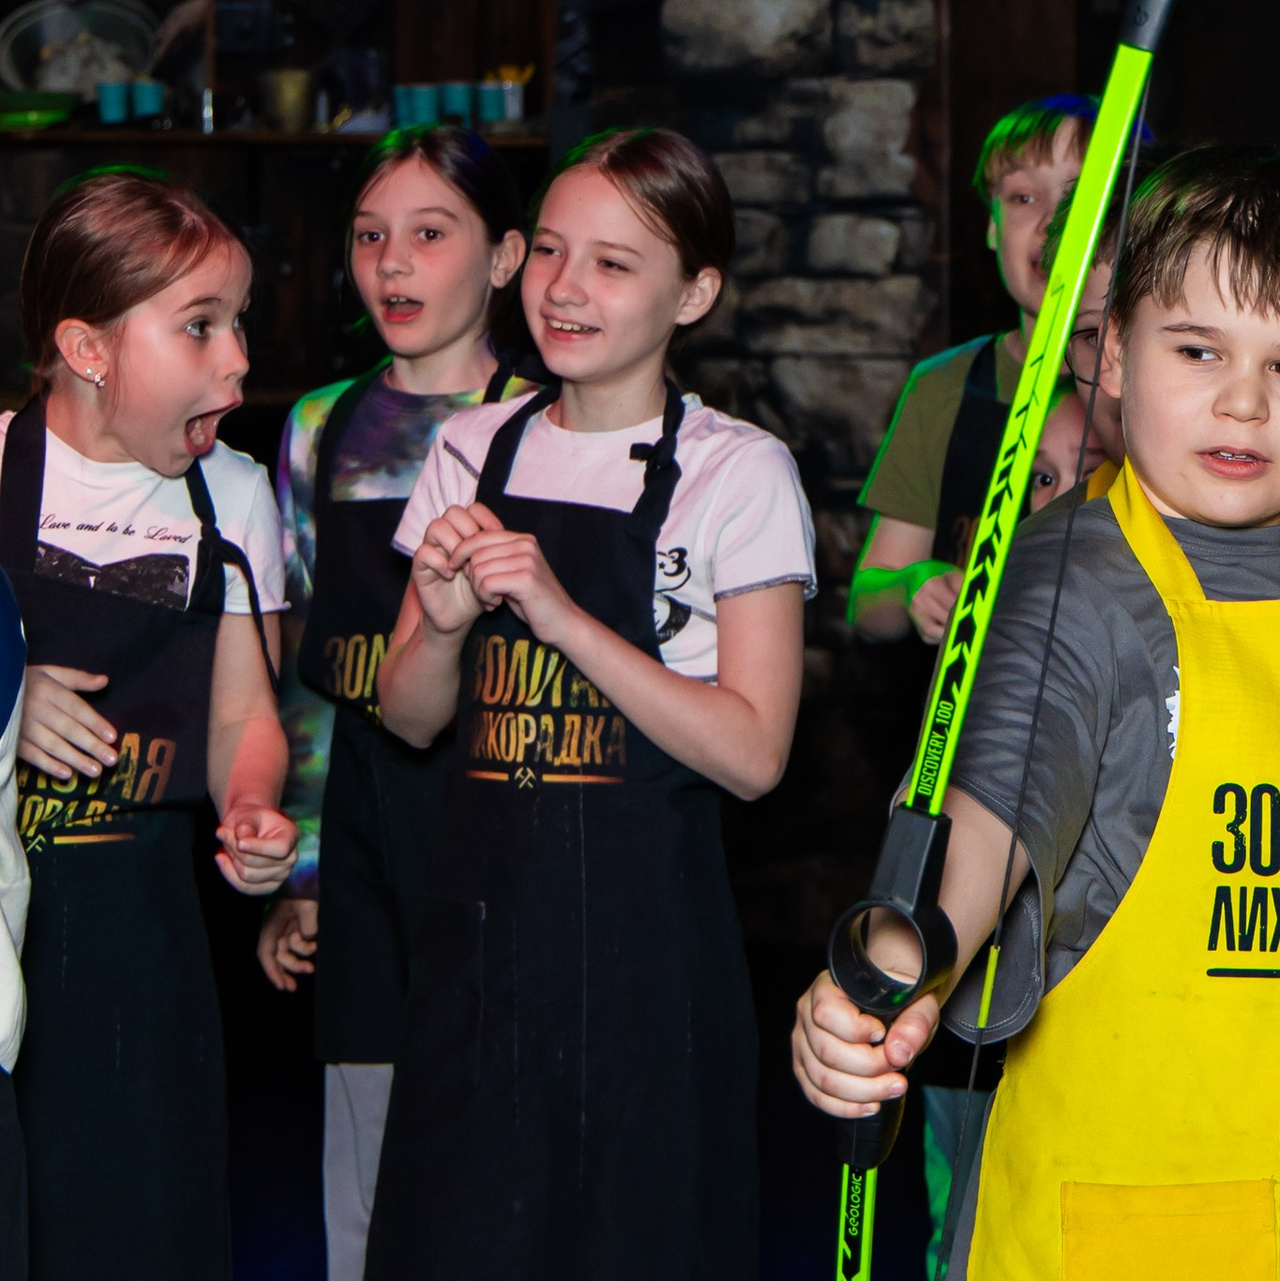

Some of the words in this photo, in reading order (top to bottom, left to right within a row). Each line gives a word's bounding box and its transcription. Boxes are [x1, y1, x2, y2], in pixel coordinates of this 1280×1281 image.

[76, 522, 104, 532] and
[106, 523, 118, 532] to
[122, 524, 136, 536] be
[917, 730, 946, 796] DISCOVERY
[935, 700, 954, 724] 100
